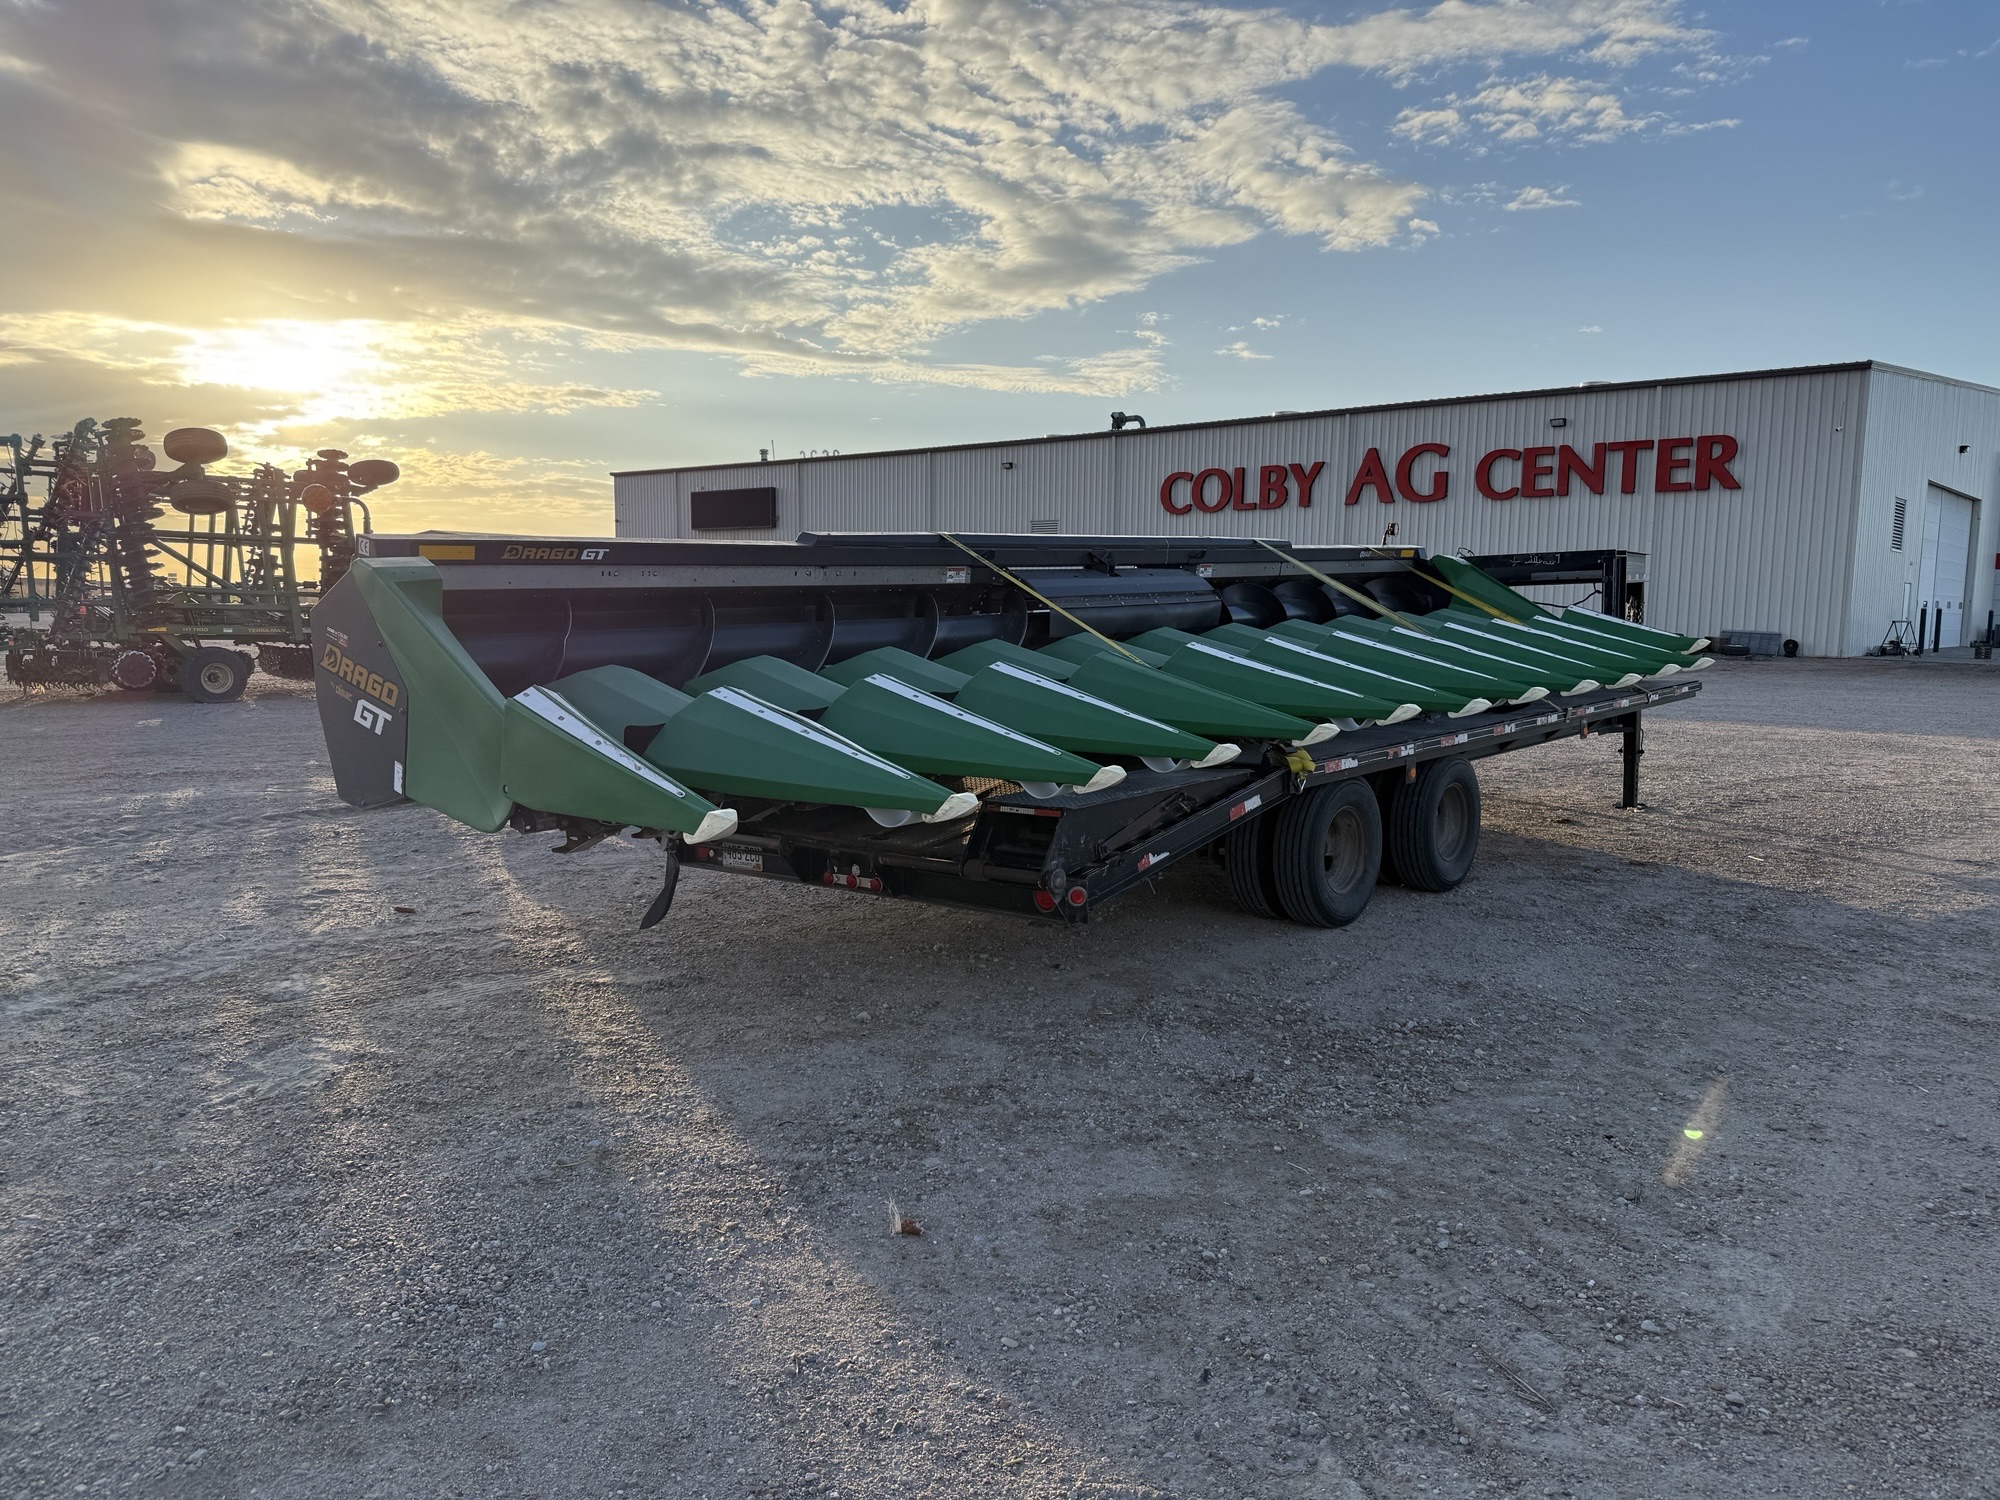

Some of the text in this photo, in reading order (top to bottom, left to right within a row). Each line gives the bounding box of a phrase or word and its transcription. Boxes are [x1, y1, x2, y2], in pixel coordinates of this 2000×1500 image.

[1160, 434, 1742, 515] COLBY AG CENTER
[501, 544, 610, 561] DRAGO GT
[320, 642, 399, 708] DRAGO
[353, 698, 393, 735] GT
